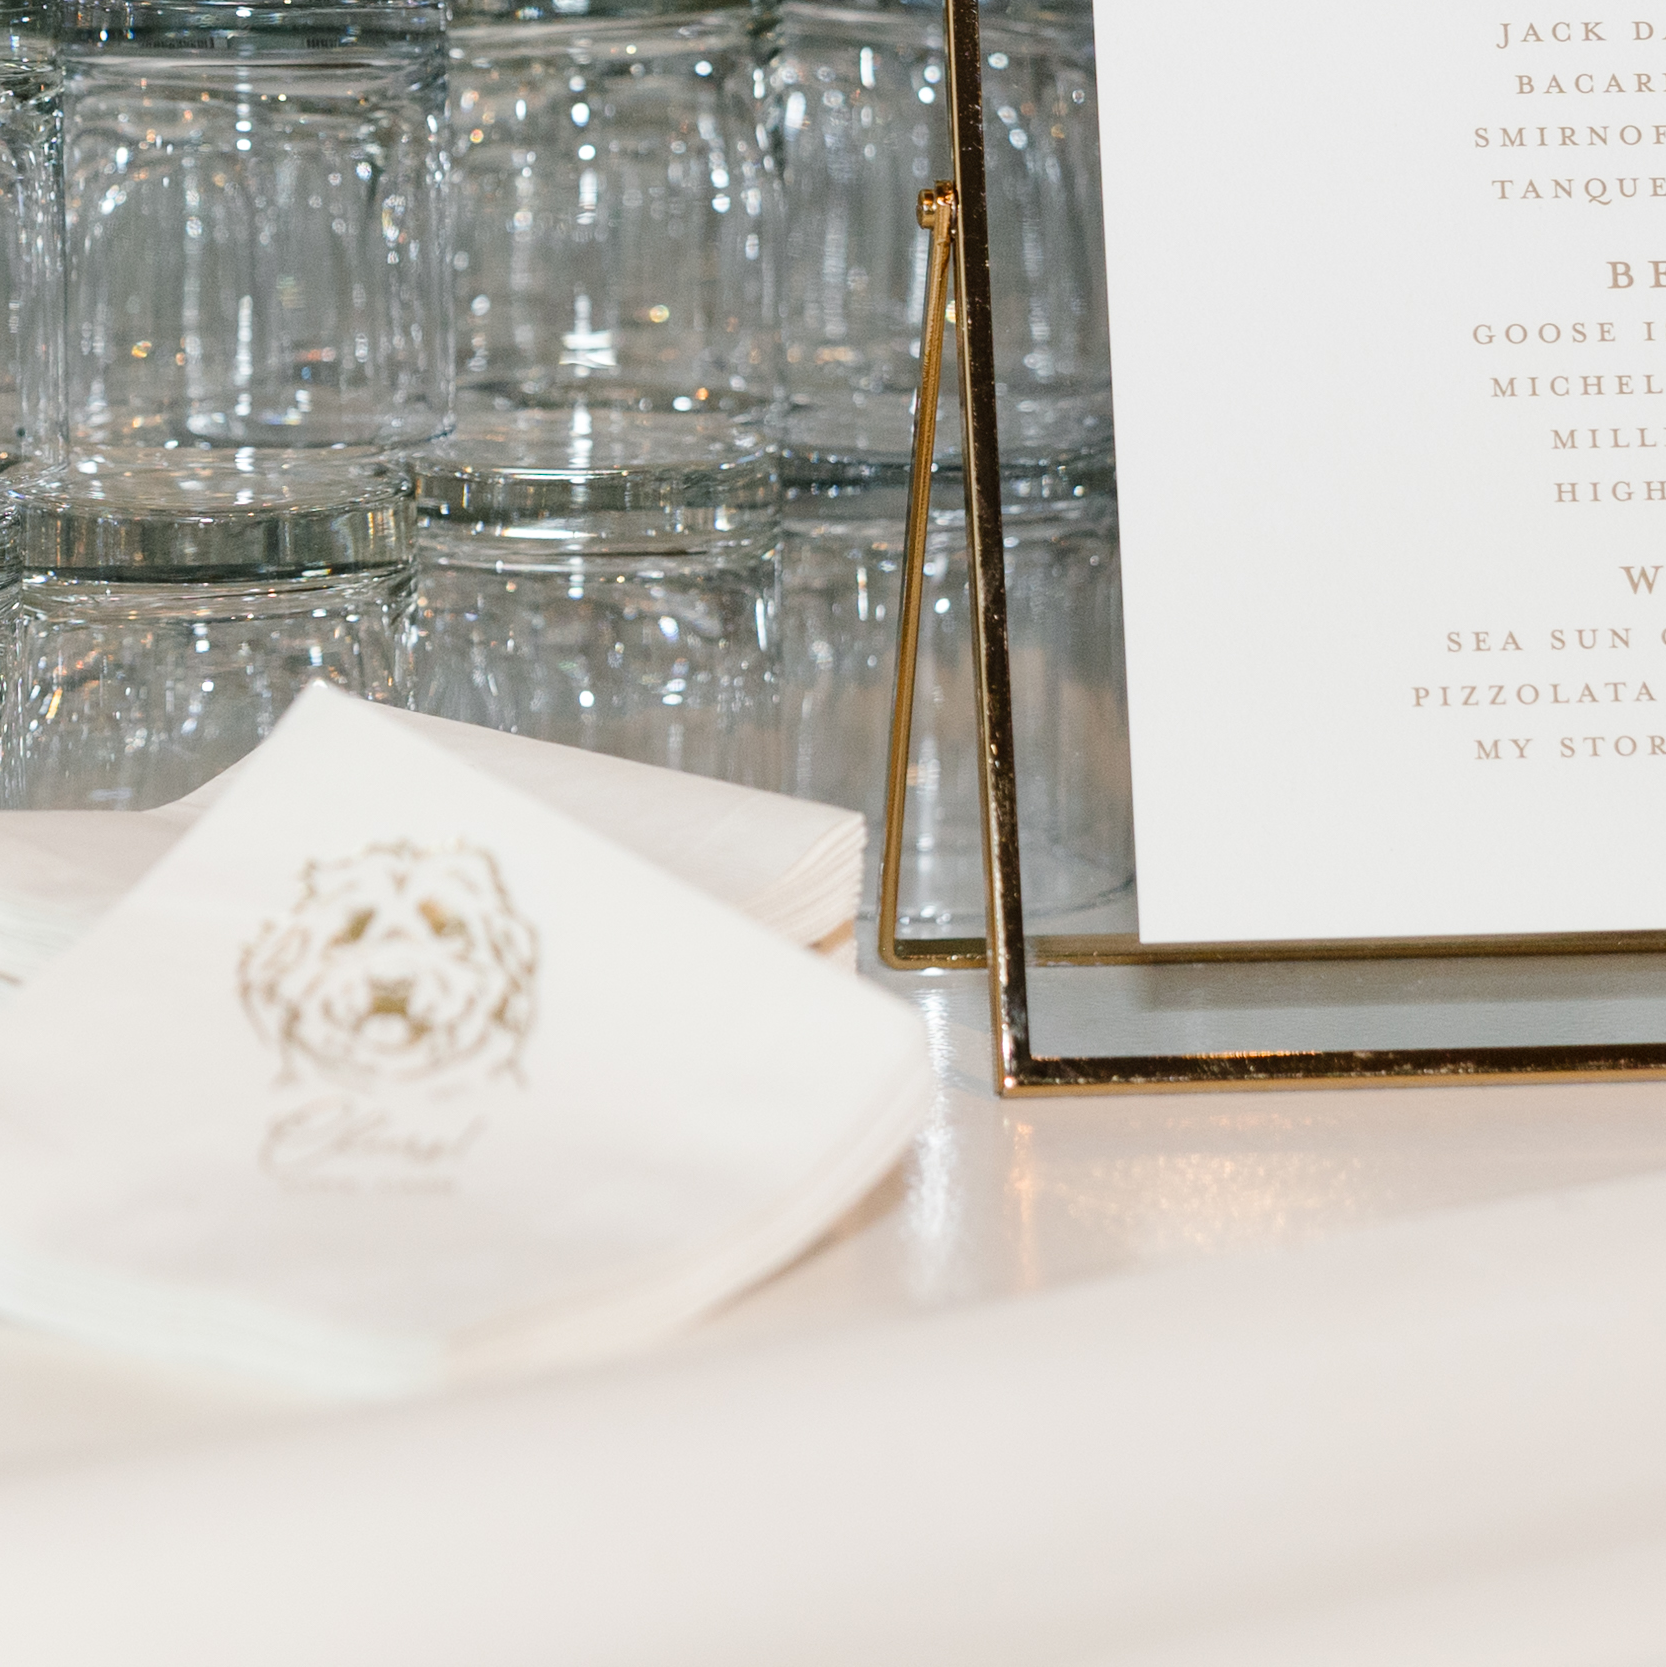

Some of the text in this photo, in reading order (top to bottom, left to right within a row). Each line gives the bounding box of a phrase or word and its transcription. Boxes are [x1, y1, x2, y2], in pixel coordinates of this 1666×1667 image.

[1495, 21, 1606, 50] JACK
[1472, 322, 1616, 345] GOOSE
[1446, 630, 1523, 653] SEA
[1550, 628, 1631, 651] SUN
[1412, 681, 1657, 707] PIZZOLATA
[1475, 738, 1532, 760] MY
